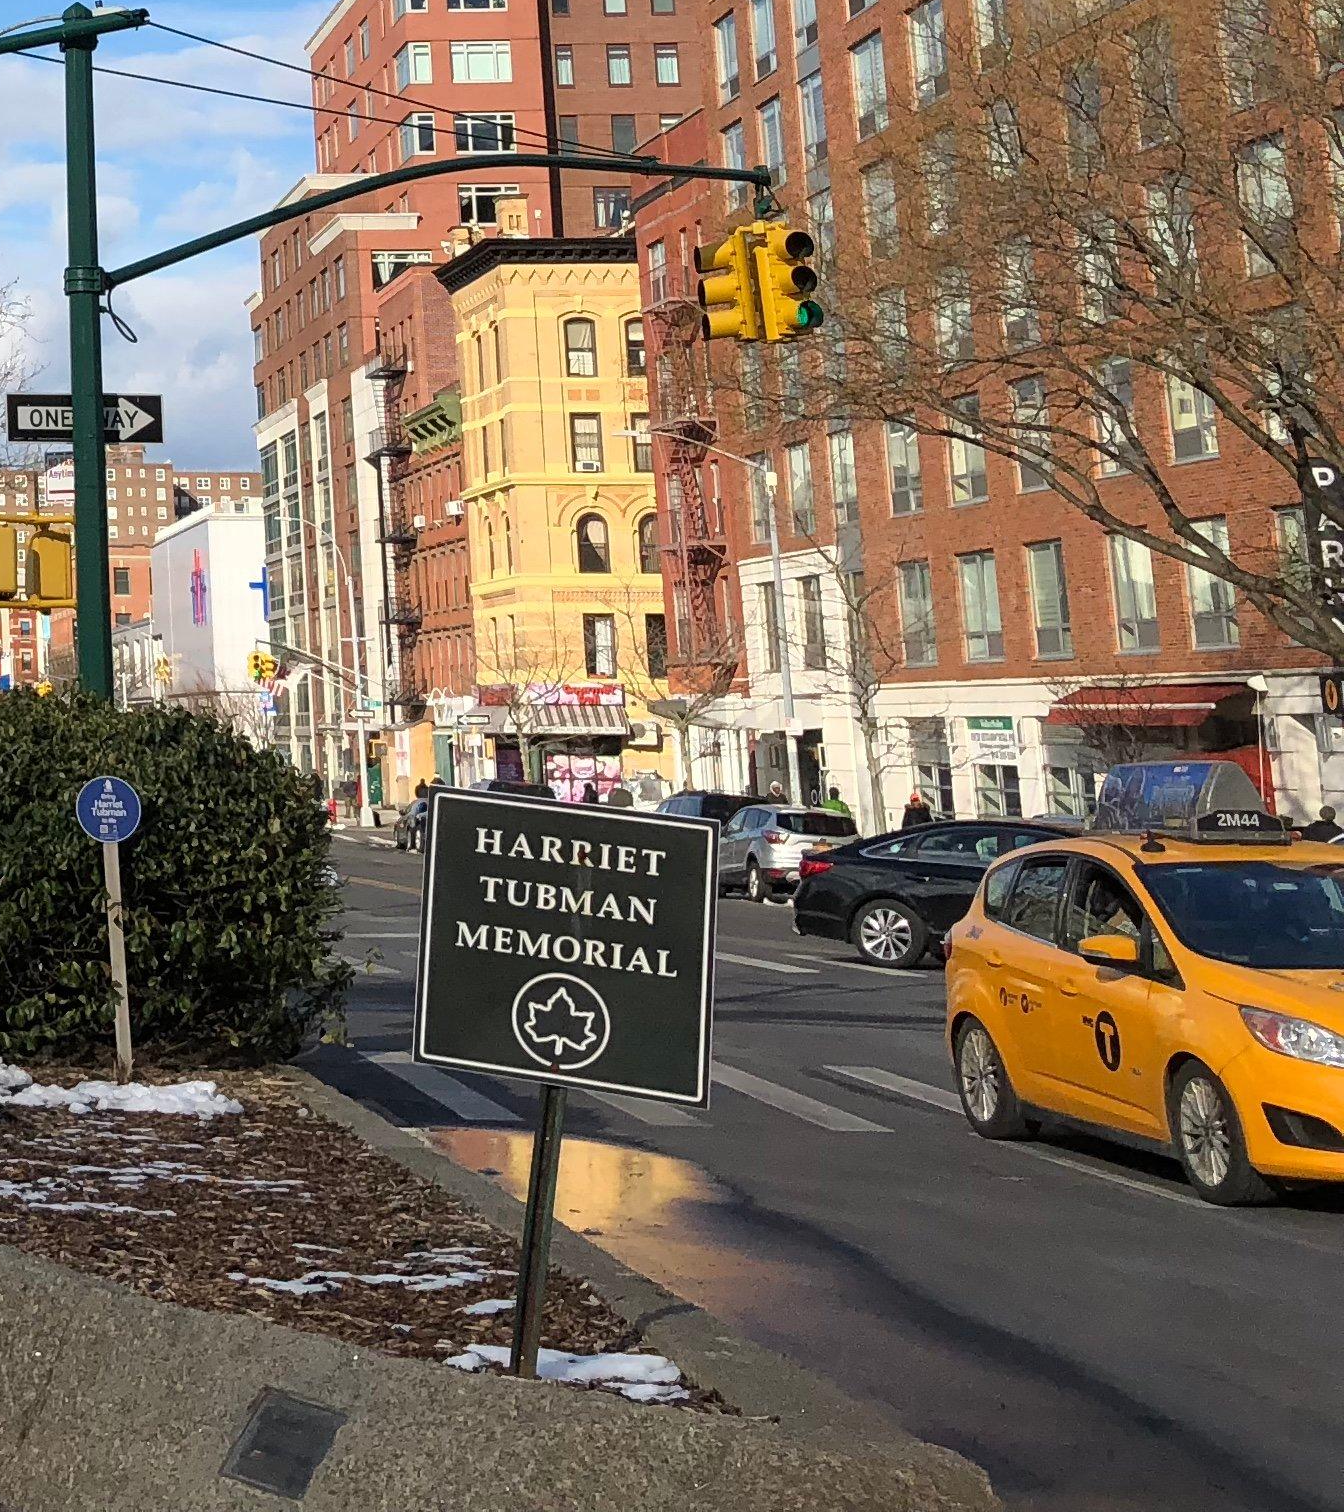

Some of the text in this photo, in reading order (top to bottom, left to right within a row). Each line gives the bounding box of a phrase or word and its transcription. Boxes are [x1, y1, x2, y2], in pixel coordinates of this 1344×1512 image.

[29, 408, 73, 427] ONE
[91, 807, 128, 817] Tubman
[94, 799, 123, 808] Harriet
[1216, 813, 1260, 827] 2M44
[474, 826, 667, 877] HARRIET
[478, 875, 658, 926] TUBMAN
[454, 921, 678, 978] MEMORIAL
